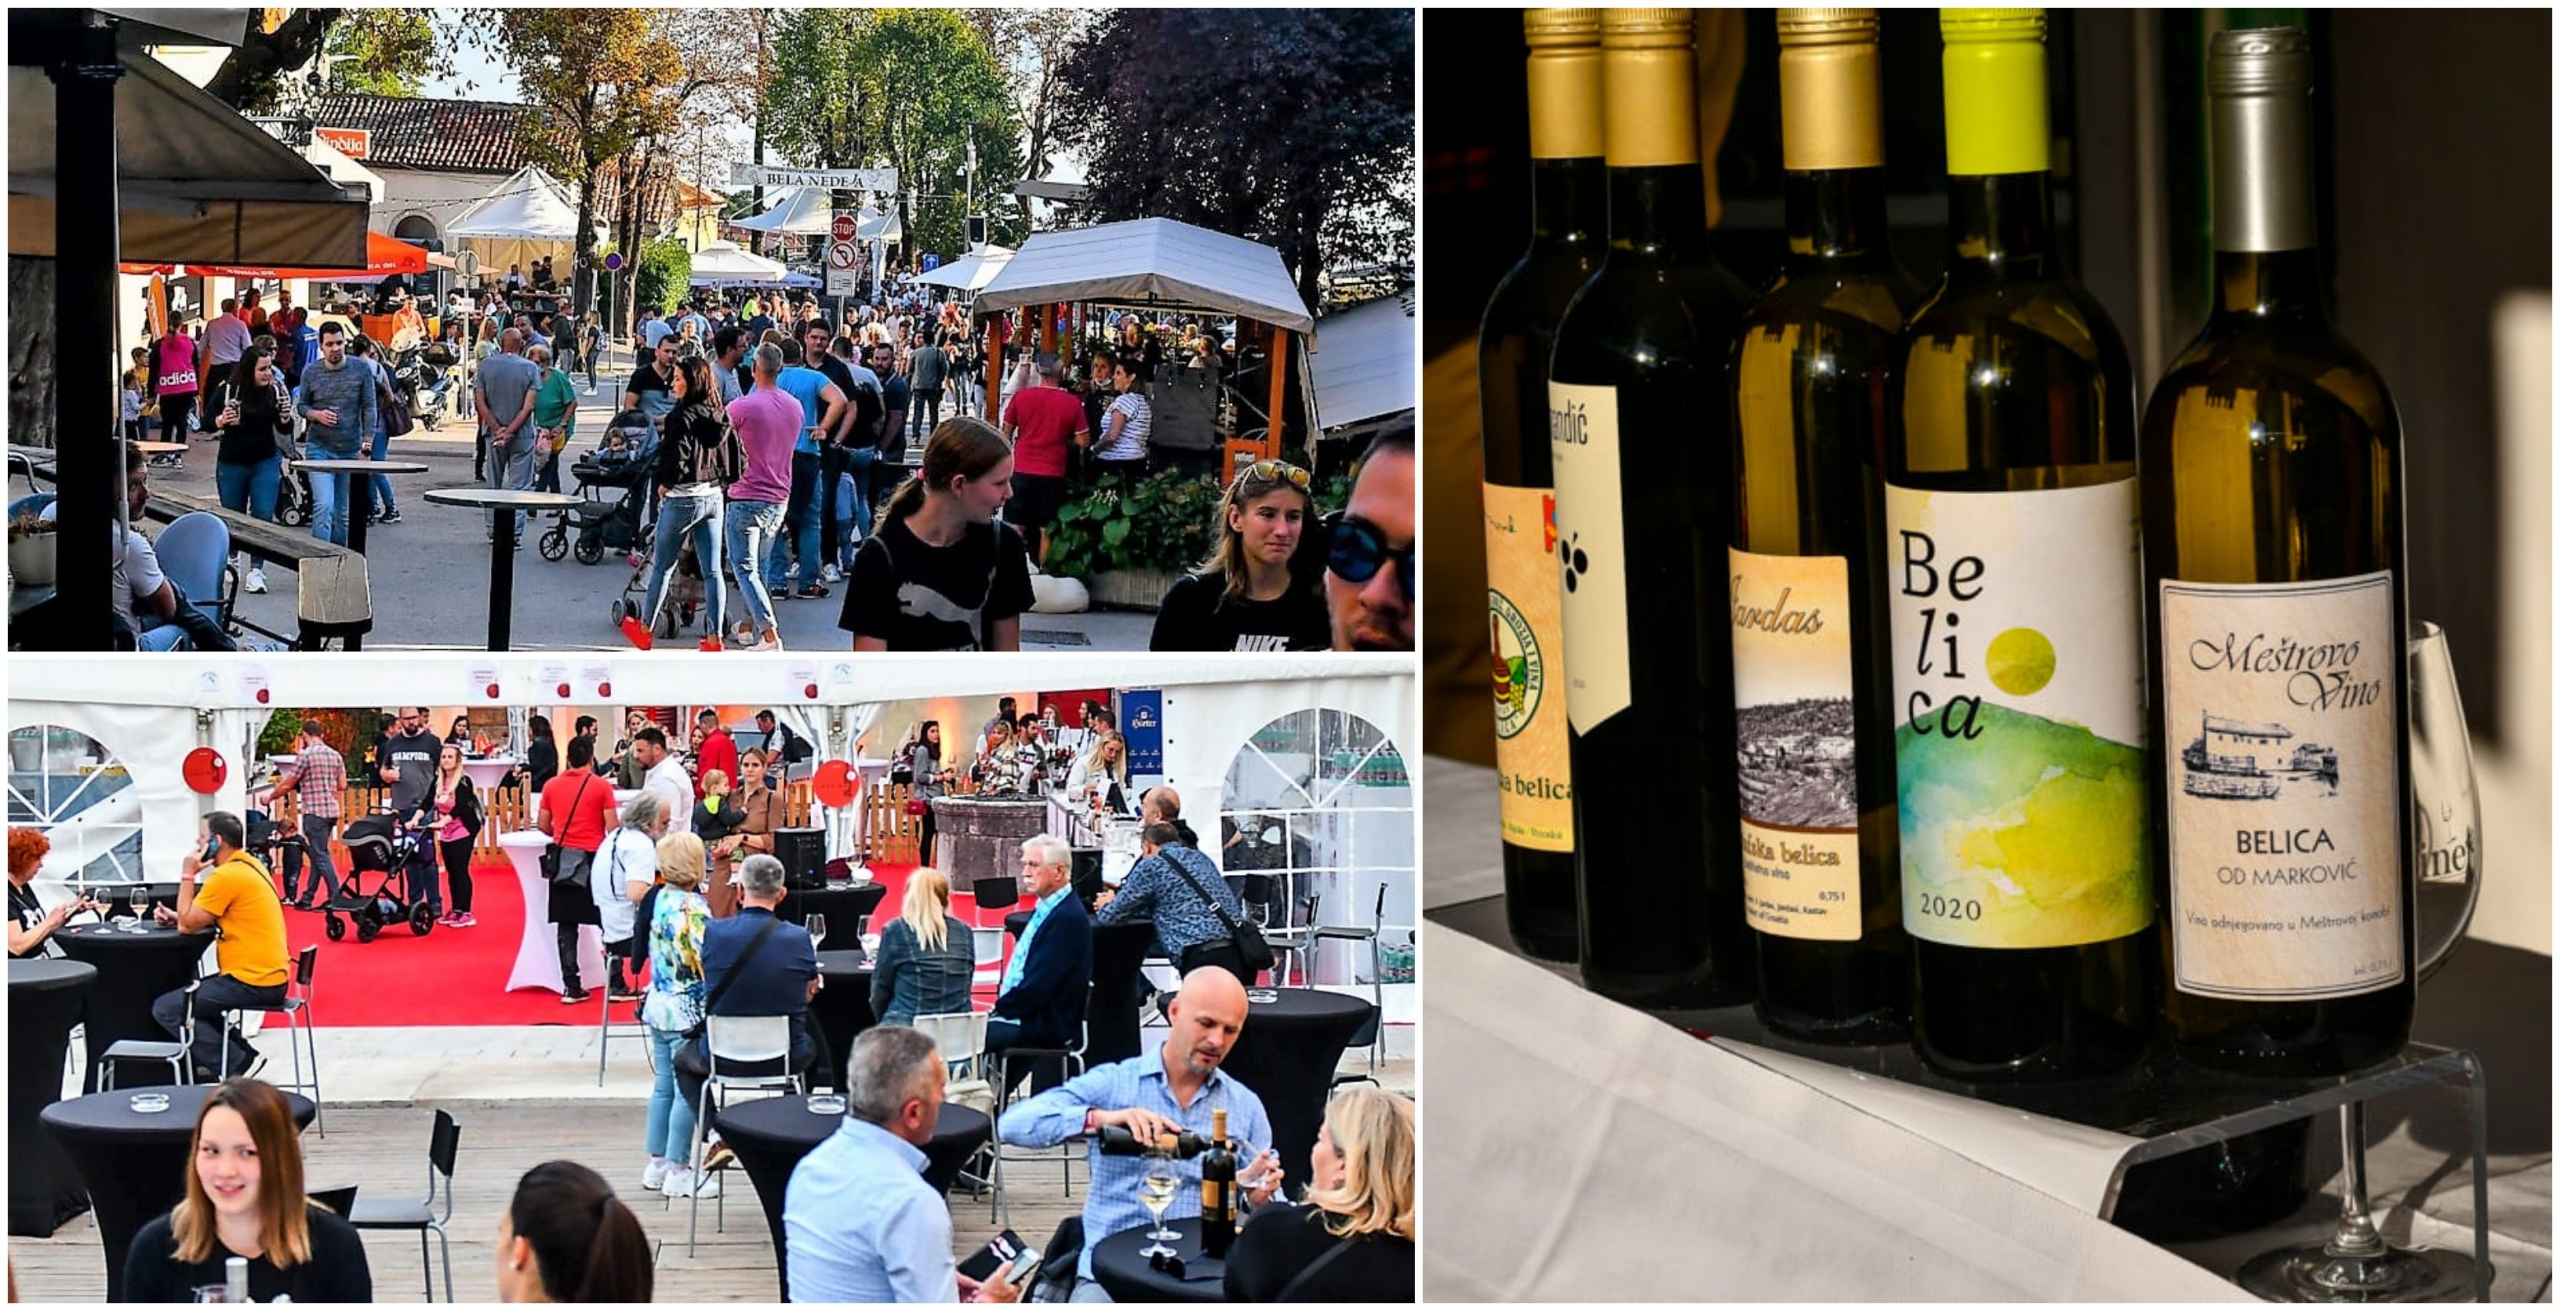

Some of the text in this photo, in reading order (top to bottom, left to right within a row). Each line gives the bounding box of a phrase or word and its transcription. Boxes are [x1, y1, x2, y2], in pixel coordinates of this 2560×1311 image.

[766, 173, 804, 186] BELA
[832, 223, 856, 236] STOP
[159, 370, 197, 386] adida
[1900, 529, 1985, 602] Be
[1234, 633, 1290, 652] NIKE
[1917, 607, 1966, 680] li
[2188, 632, 2361, 673] Meštrovo
[2286, 670, 2382, 712] Vino
[1908, 690, 1985, 741] ca
[1779, 841, 1841, 867] belica
[2236, 828, 2336, 855] BELICA
[2216, 856, 2359, 886] OD MARKOVIĆ
[1921, 892, 1982, 922] 2020
[2185, 910, 2208, 928] Vino
[2286, 920, 2296, 931] u
